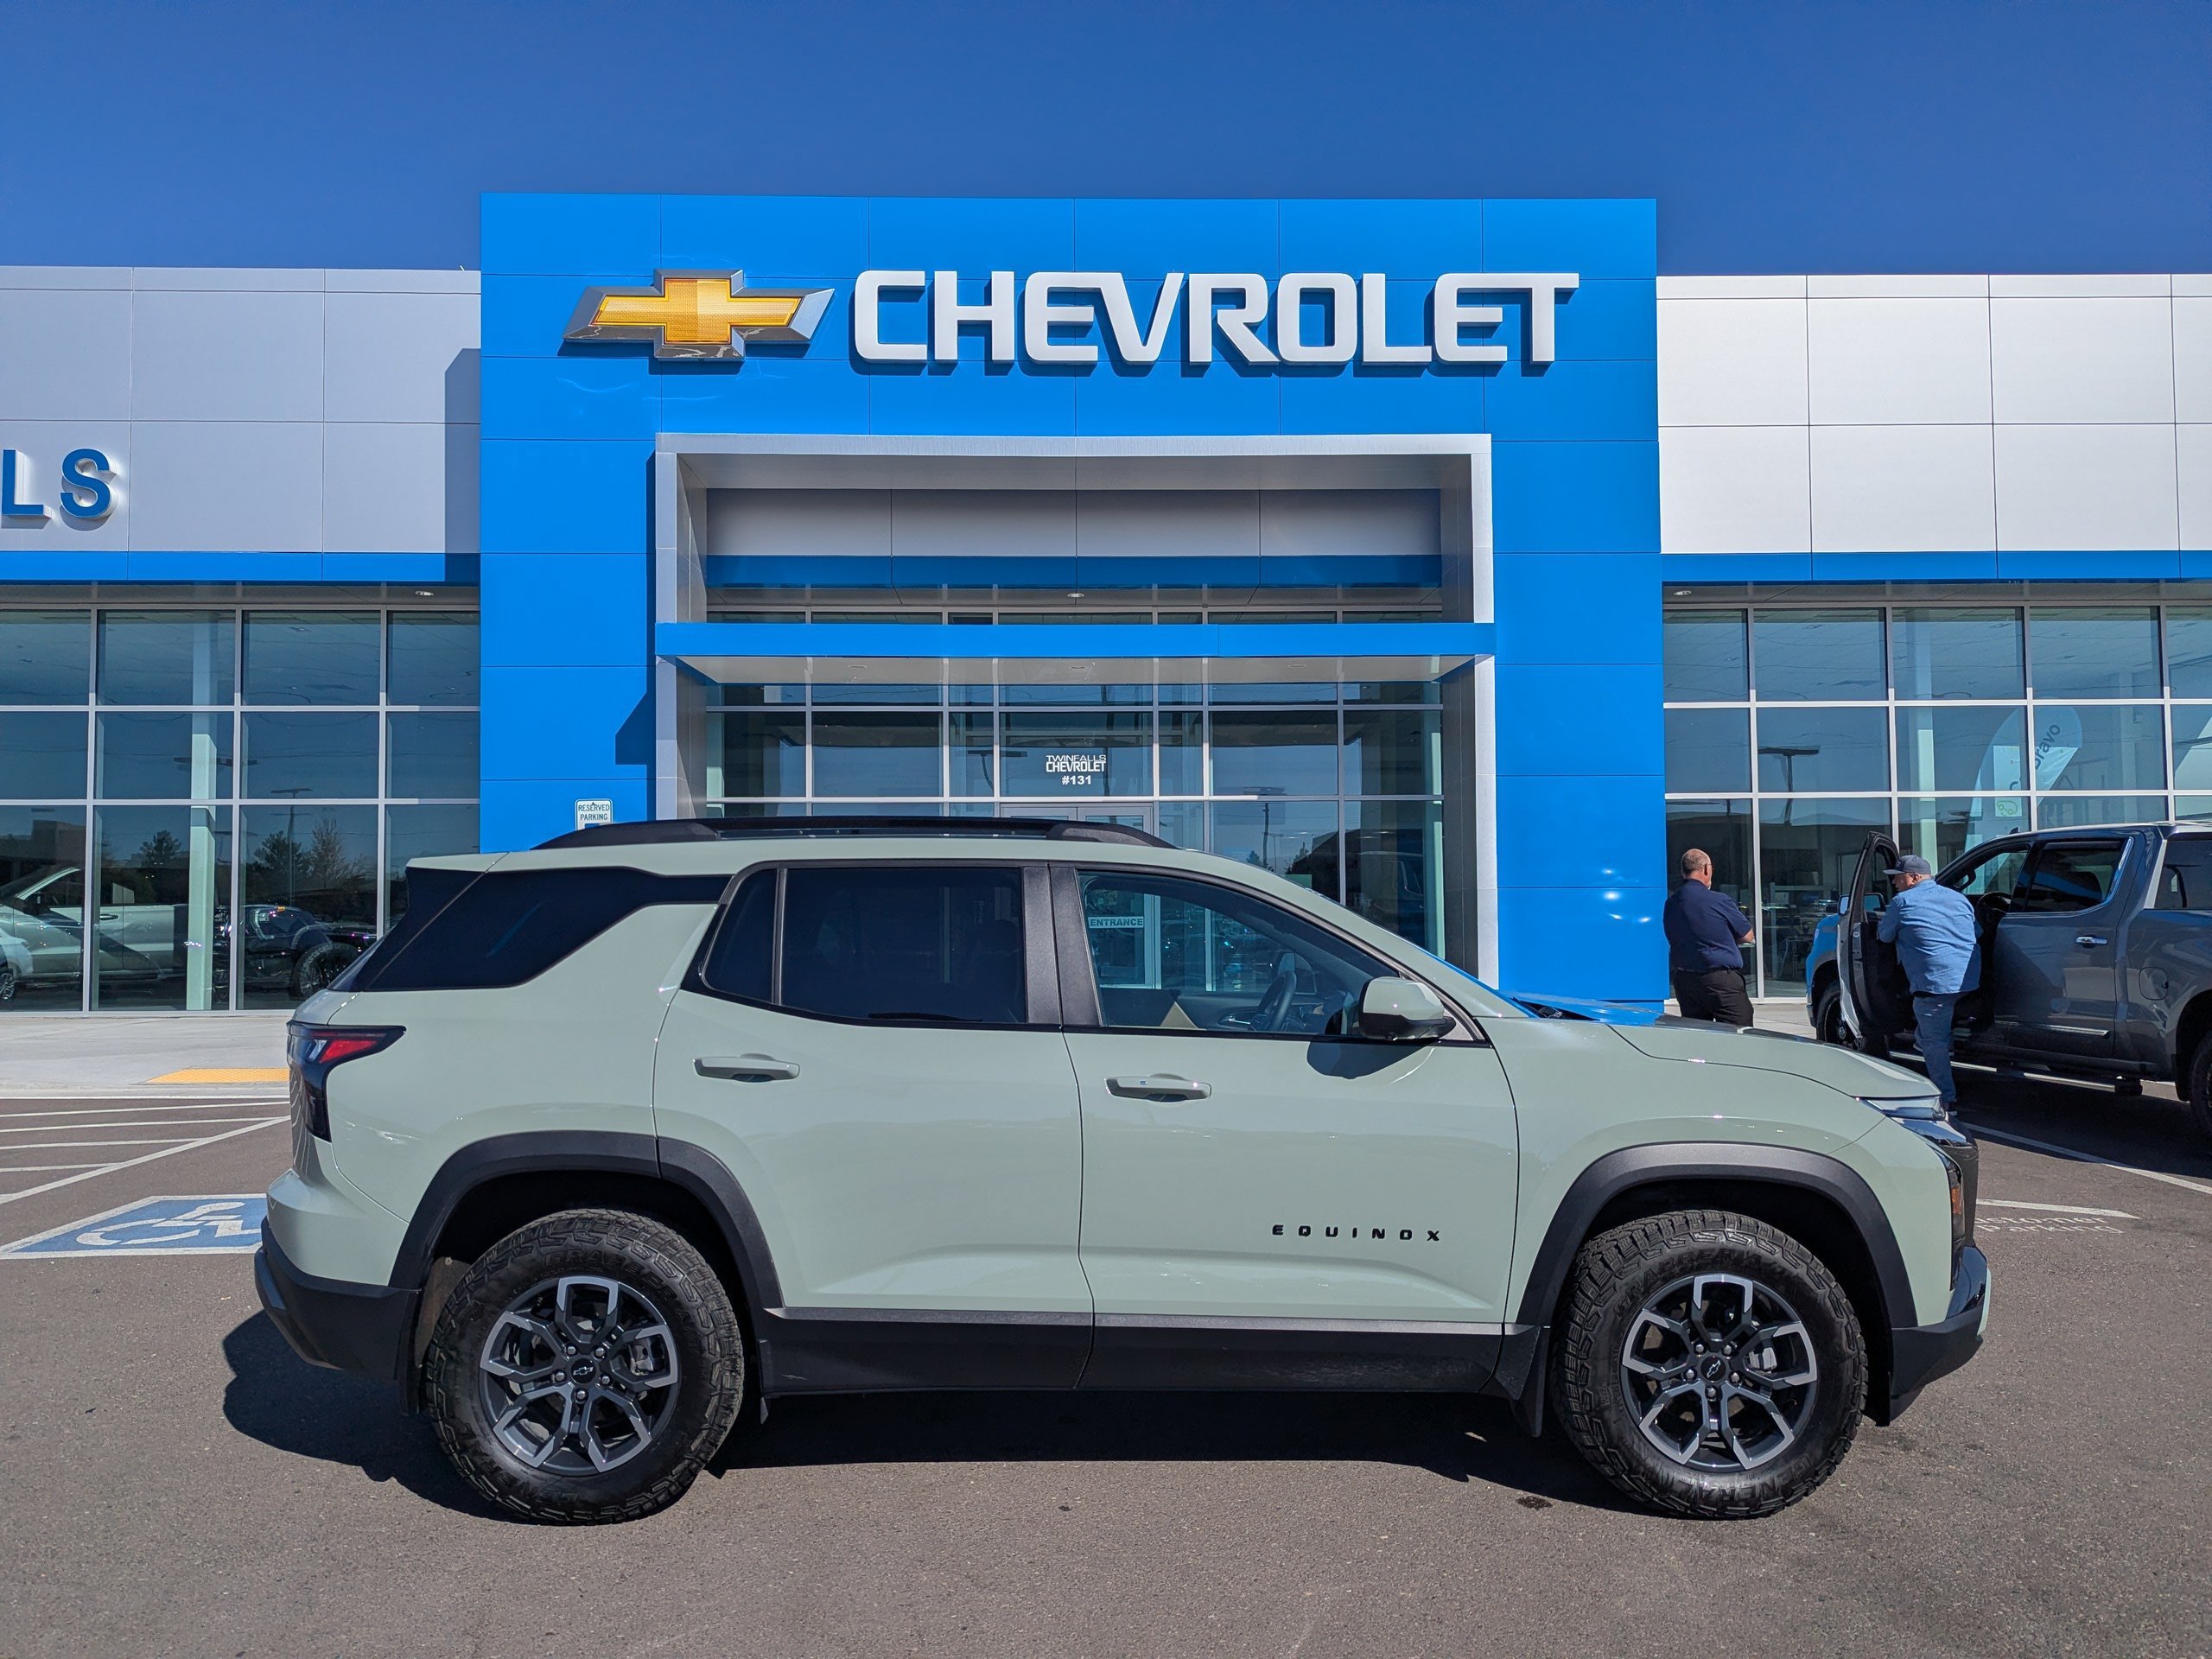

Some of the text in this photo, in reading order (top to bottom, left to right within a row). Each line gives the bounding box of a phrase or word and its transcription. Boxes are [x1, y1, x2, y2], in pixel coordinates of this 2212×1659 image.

[854, 270, 1580, 364] CHEVROLET
[1046, 761, 1106, 772] CHEVROLET
[1062, 775, 1091, 785] #131
[1272, 1224, 1440, 1242] EQUINOX
